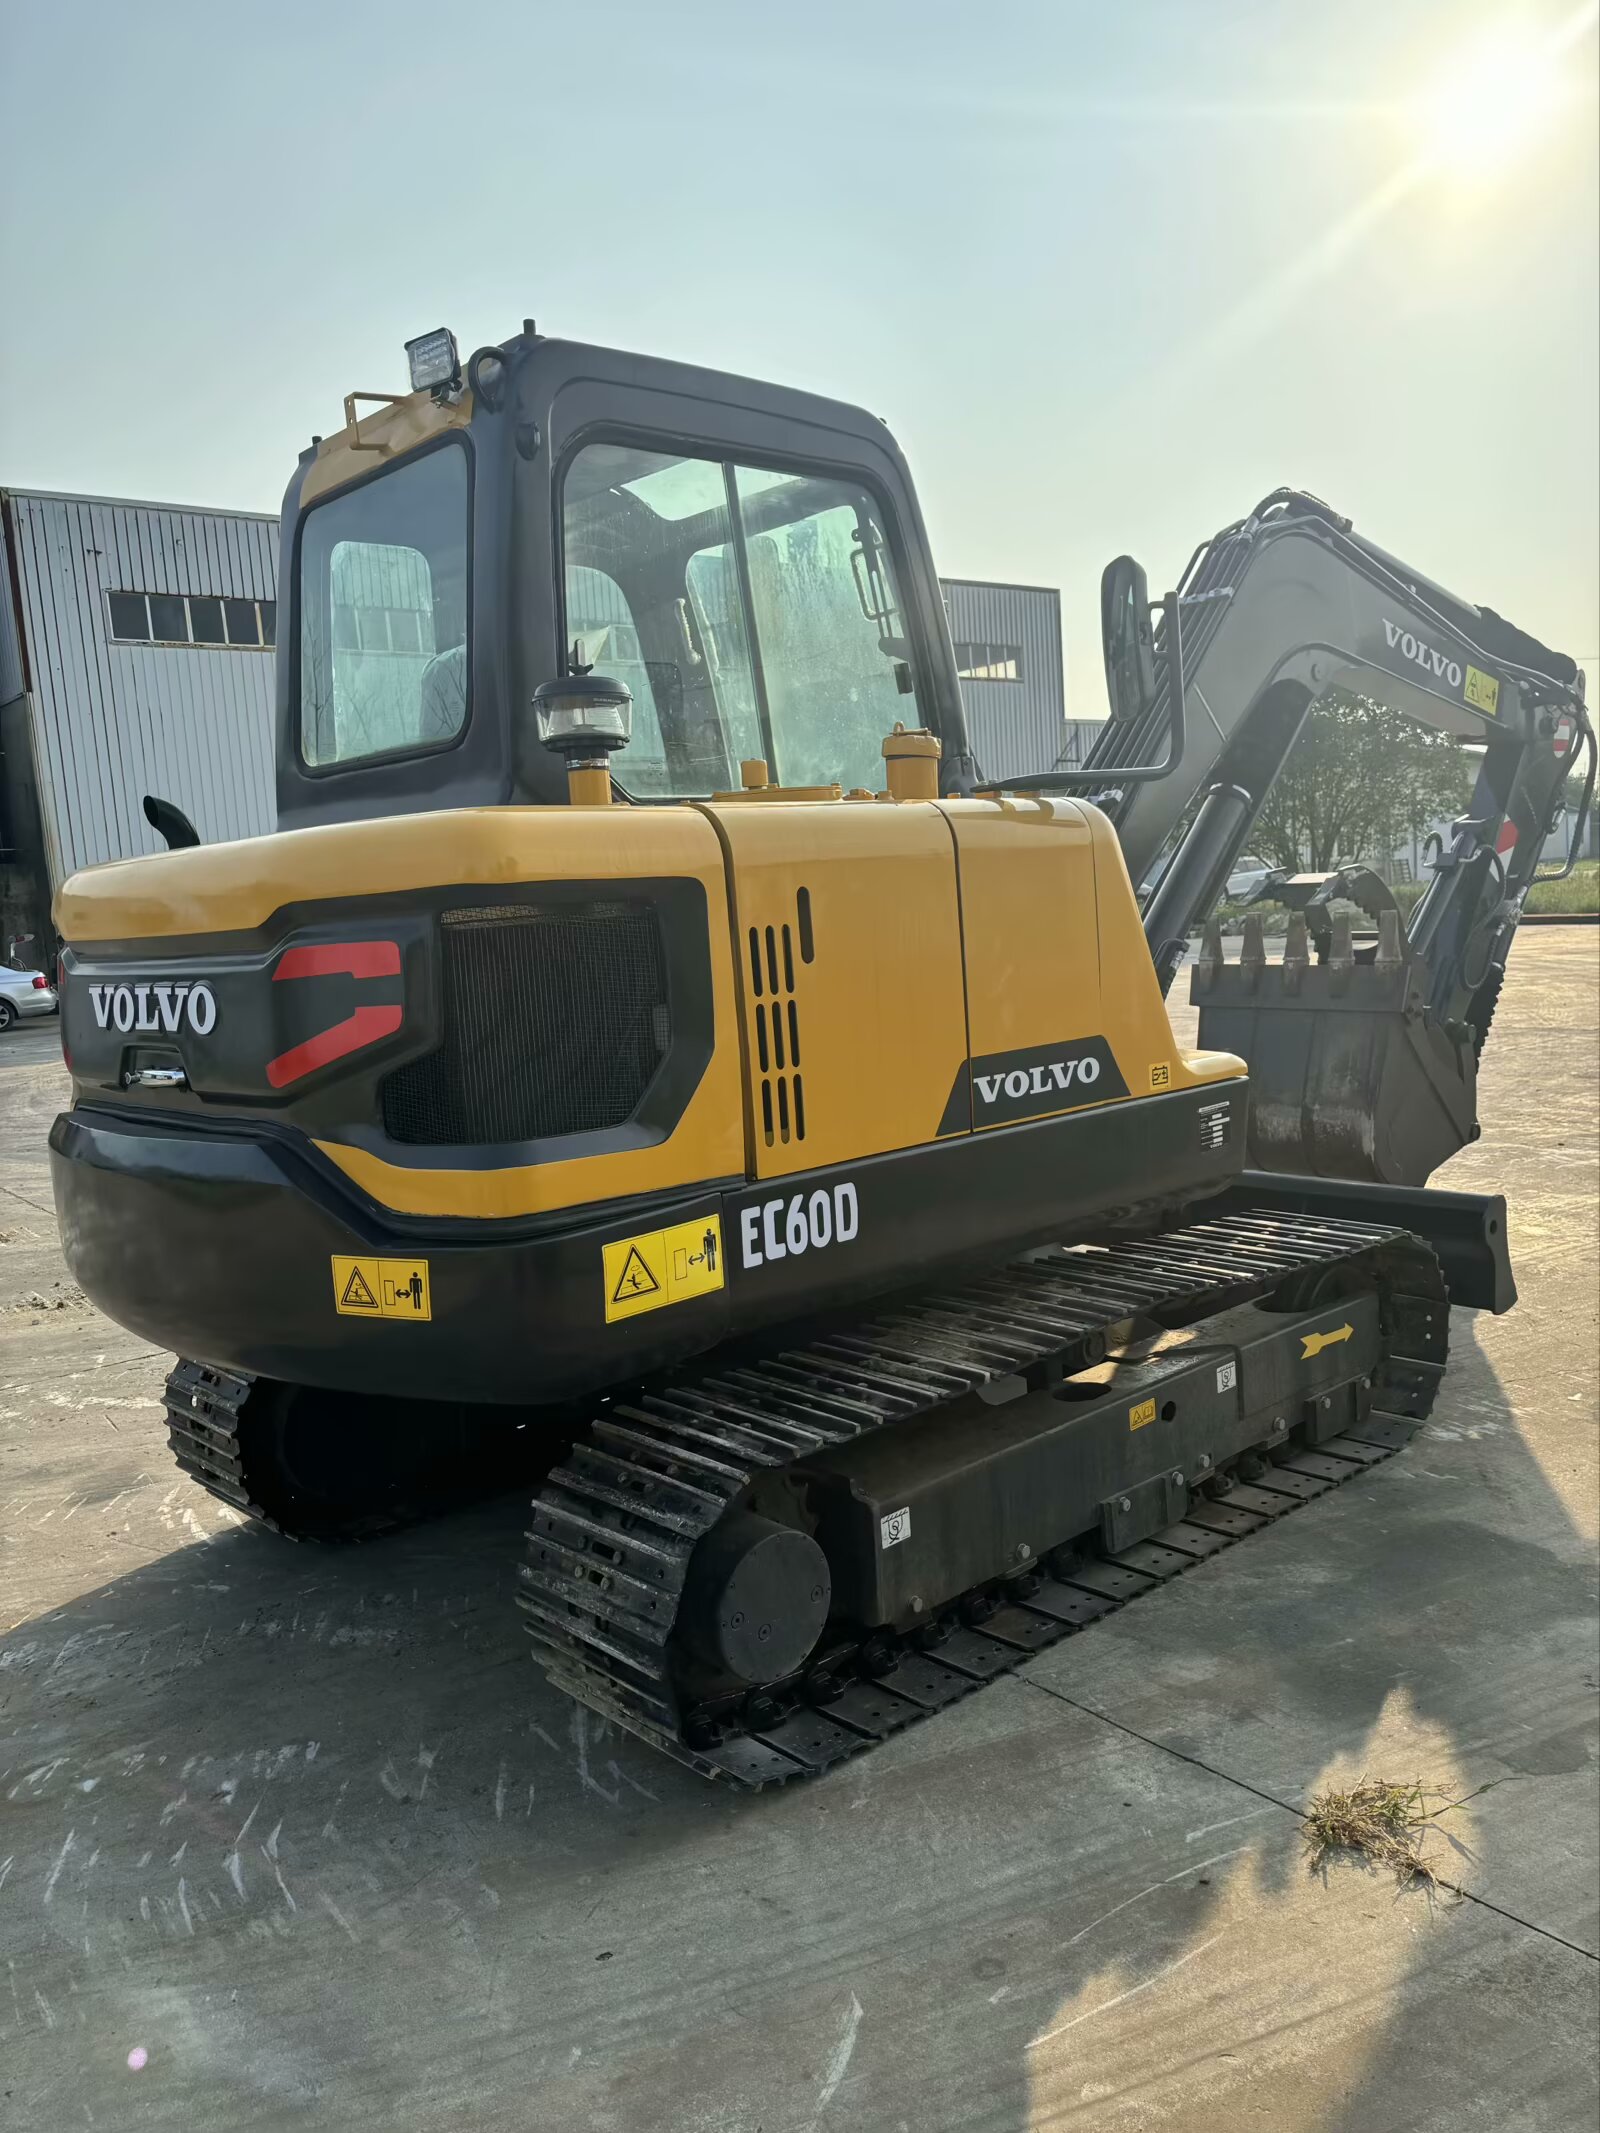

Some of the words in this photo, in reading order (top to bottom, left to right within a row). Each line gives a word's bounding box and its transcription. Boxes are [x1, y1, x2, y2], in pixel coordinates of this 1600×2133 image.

[1382, 618, 1462, 687] VOLVO
[88, 982, 217, 1036] VOLVO
[974, 1057, 1100, 1103] VOLVO
[740, 1182, 859, 1269] EC60D
